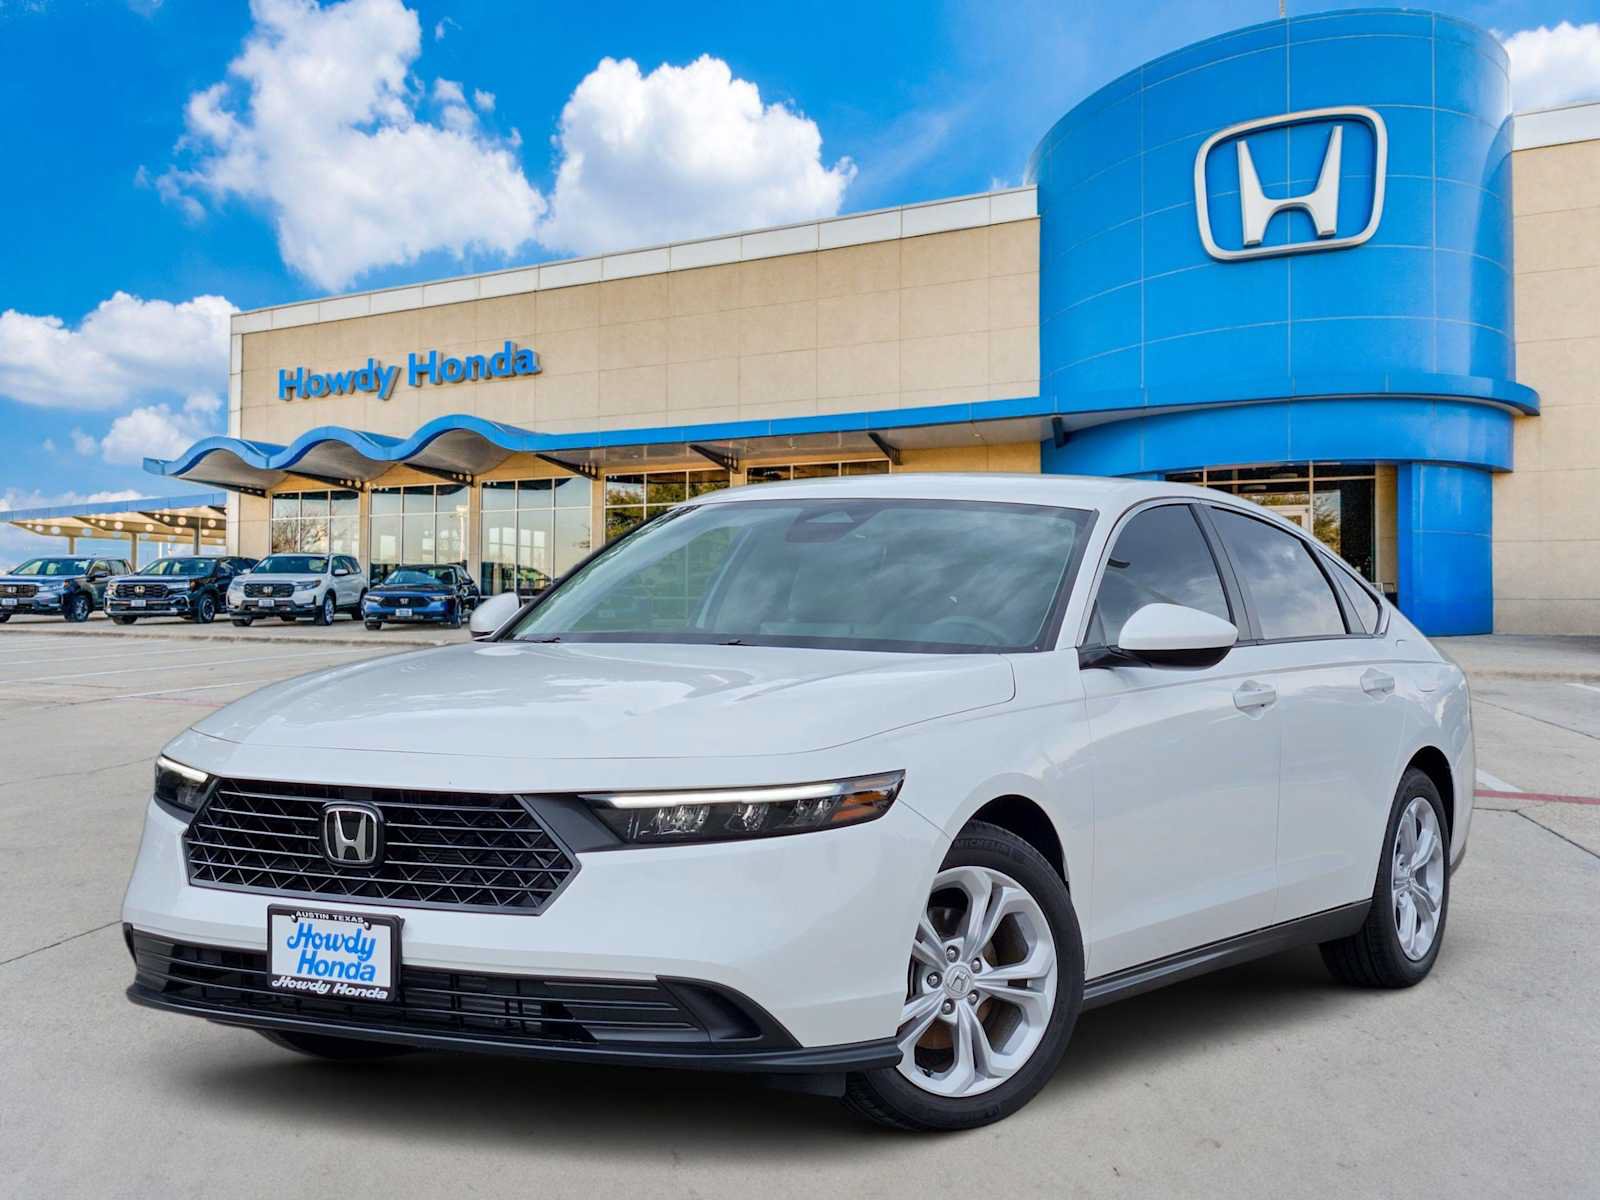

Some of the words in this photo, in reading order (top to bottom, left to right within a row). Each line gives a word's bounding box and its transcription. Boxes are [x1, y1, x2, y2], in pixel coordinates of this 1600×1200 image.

[278, 357, 401, 401] Howdy
[407, 340, 541, 388] Honda
[296, 910, 330, 920] AUSTIN
[333, 914, 364, 923] TEXAS
[286, 922, 376, 962] Howdy
[296, 949, 376, 982] Honda
[271, 976, 331, 994] Howdy
[332, 982, 388, 999] Honda
